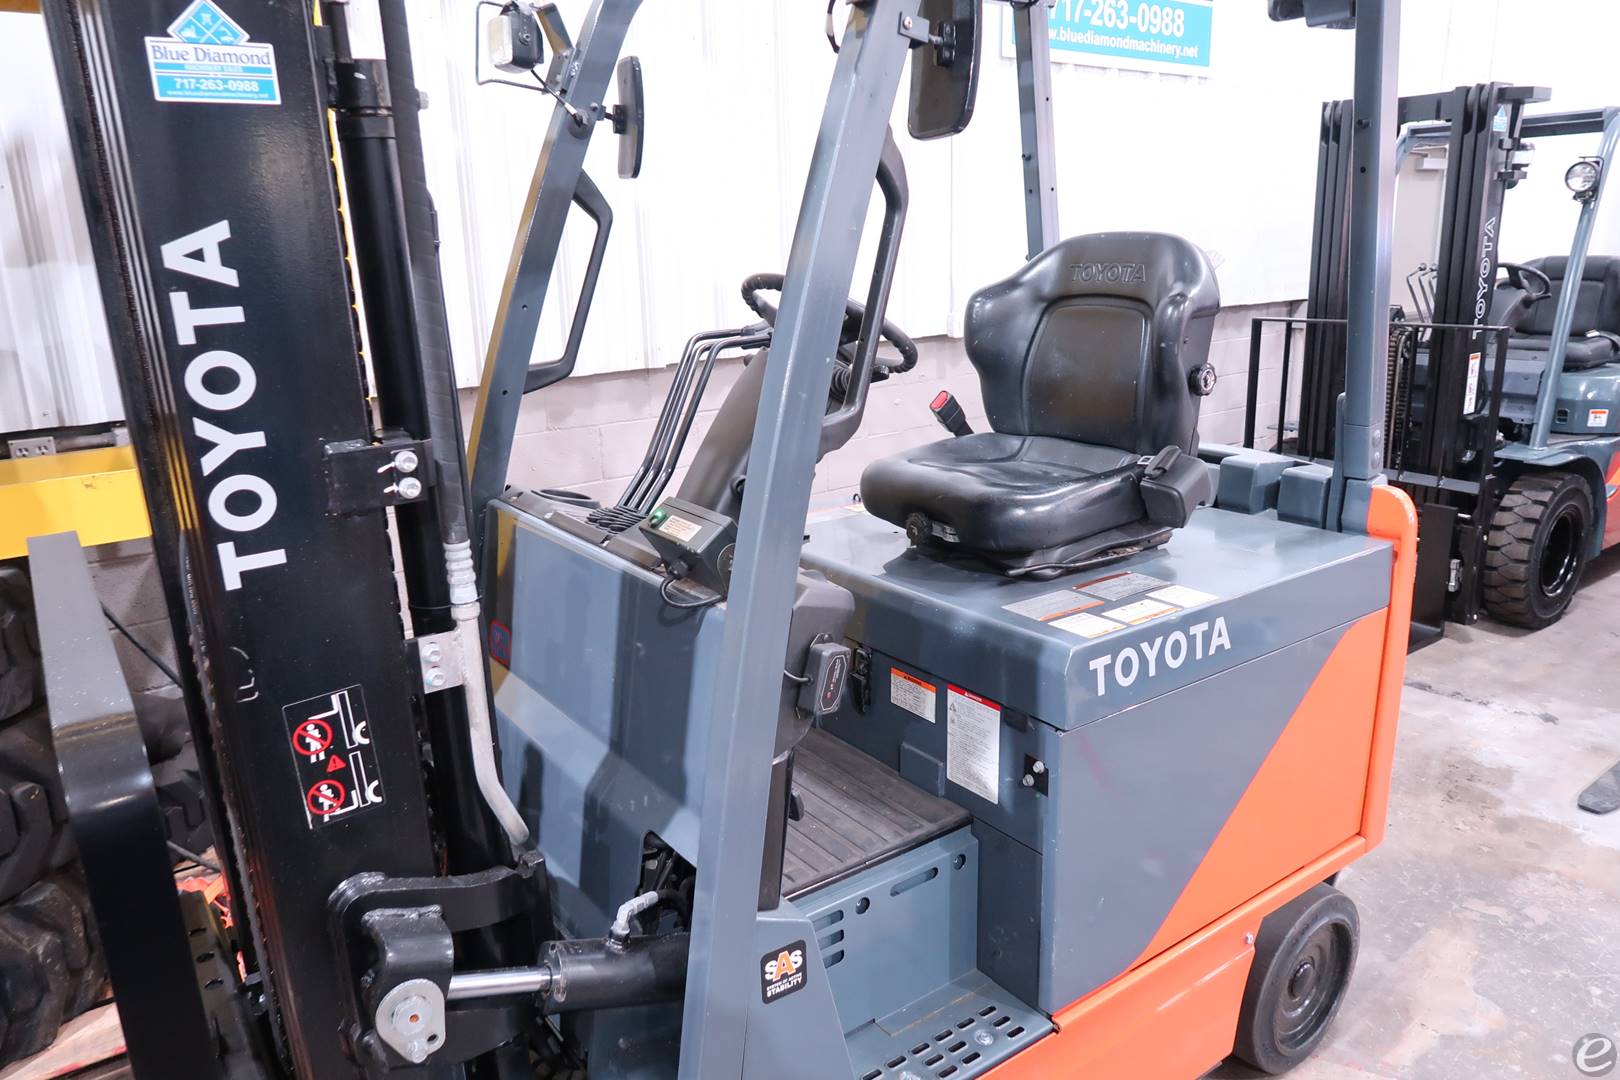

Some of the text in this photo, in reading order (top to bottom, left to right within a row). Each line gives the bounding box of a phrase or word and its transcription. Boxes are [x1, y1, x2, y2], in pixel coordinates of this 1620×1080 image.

[151, 45, 271, 65] Blue Diamond
[174, 78, 260, 92] 717-263-0988
[1070, 263, 1146, 283] TOYOTA
[1472, 216, 1497, 339] TOYOTA
[160, 219, 287, 591] TOYOTA
[1089, 616, 1232, 697] TOYOTA
[765, 950, 803, 982] SAS
[767, 977, 803, 998] STABILITY
